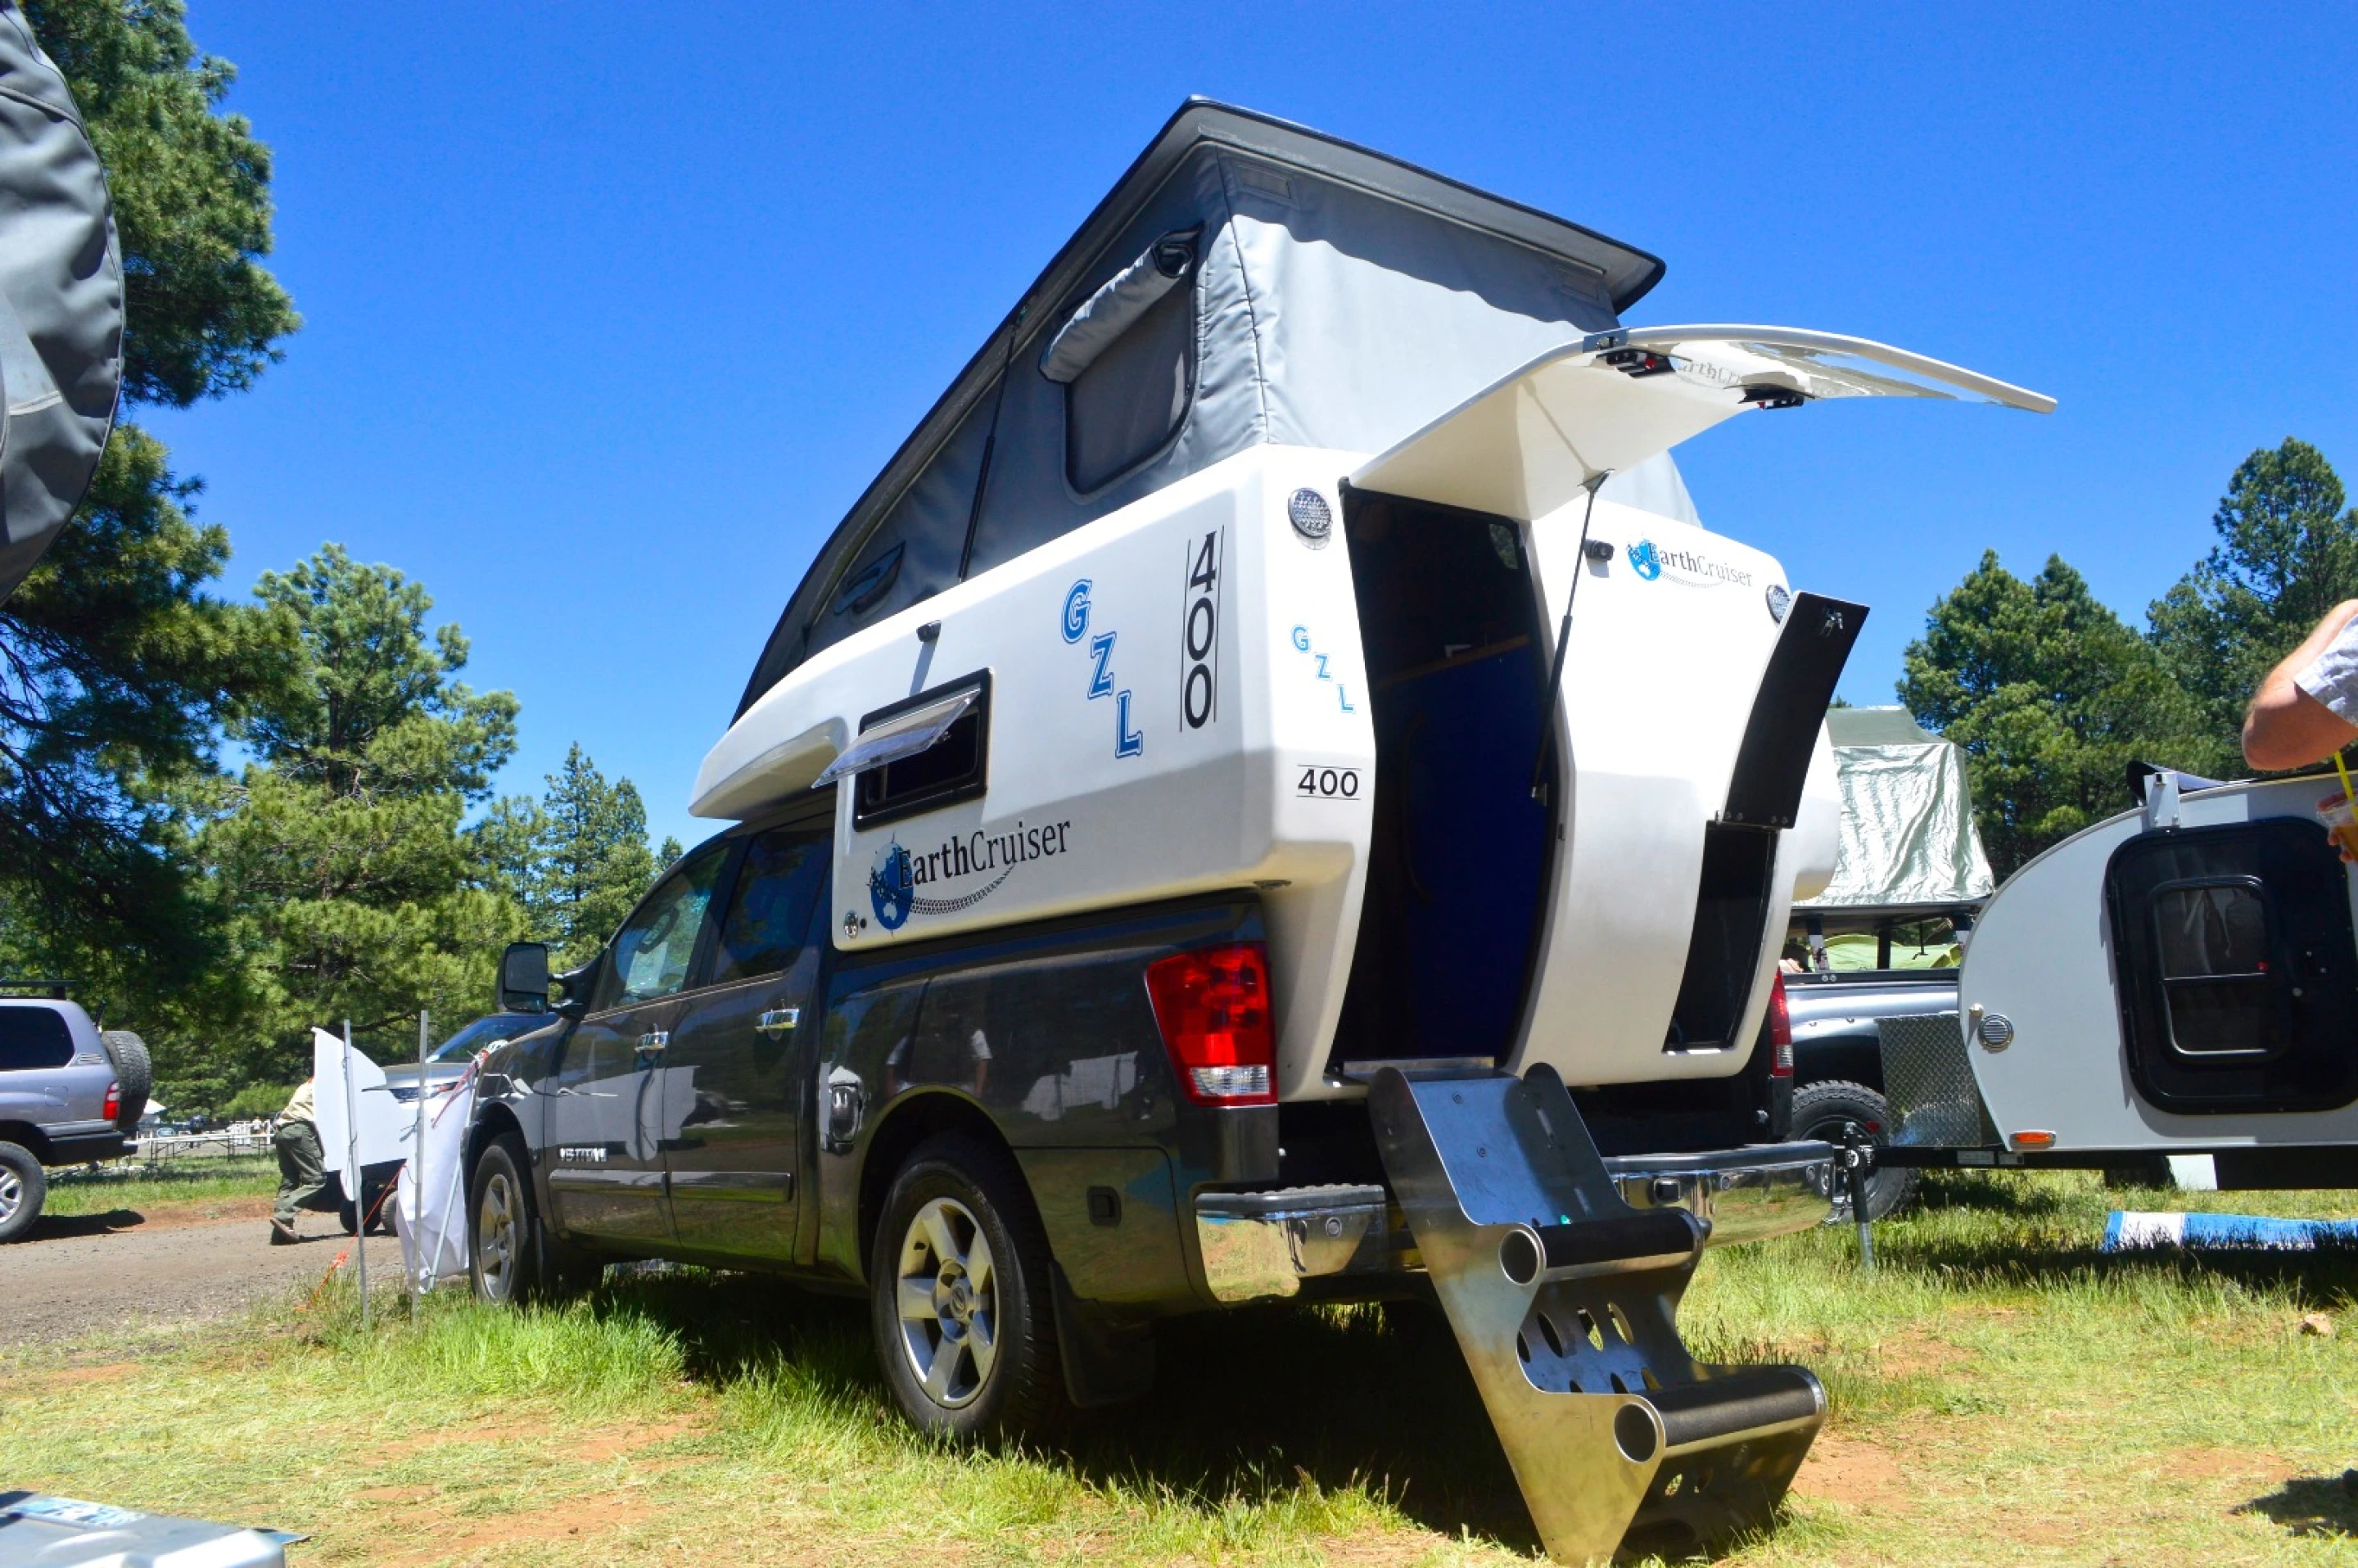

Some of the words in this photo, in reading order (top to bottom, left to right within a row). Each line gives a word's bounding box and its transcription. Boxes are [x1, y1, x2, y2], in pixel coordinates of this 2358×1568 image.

[1647, 542, 1752, 587] EarthCruiser
[1184, 531, 1217, 729] 400
[1297, 768, 1359, 798] 400
[899, 819, 1071, 890] EarthCruiser
